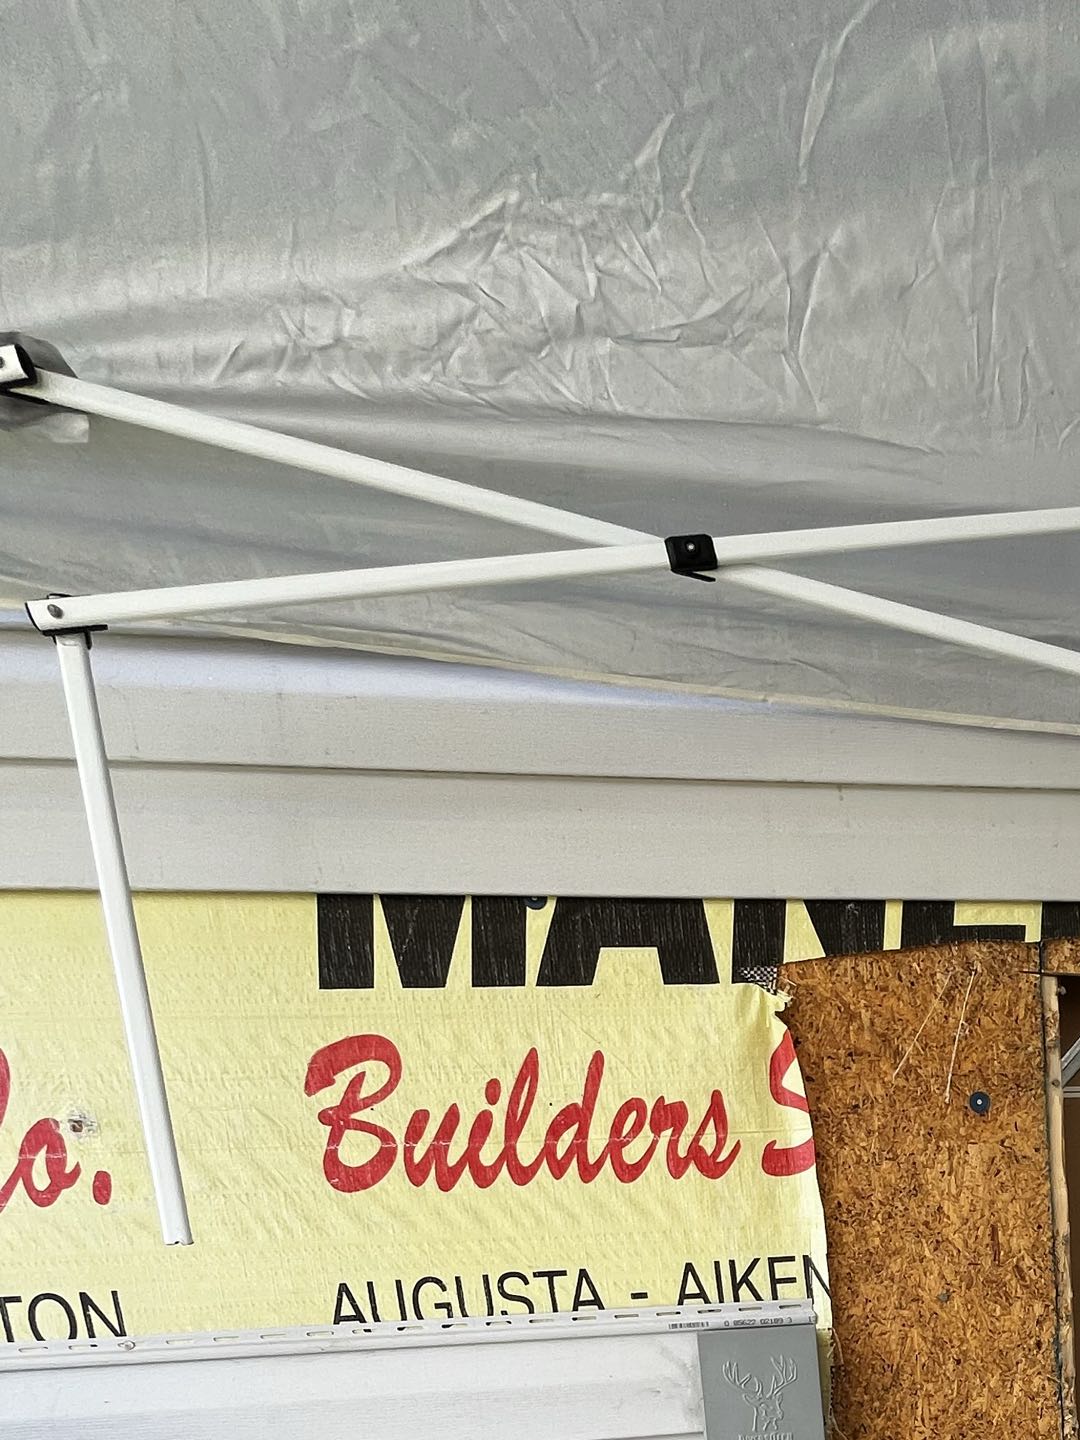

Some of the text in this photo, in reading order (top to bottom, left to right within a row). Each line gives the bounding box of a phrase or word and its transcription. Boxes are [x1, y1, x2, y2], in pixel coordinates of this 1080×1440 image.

[0, 1047, 111, 1208] o.
[304, 1034, 741, 1193] Builders
[333, 1268, 606, 1327] AUGUSTA
[677, 1255, 831, 1307] AIKEN
